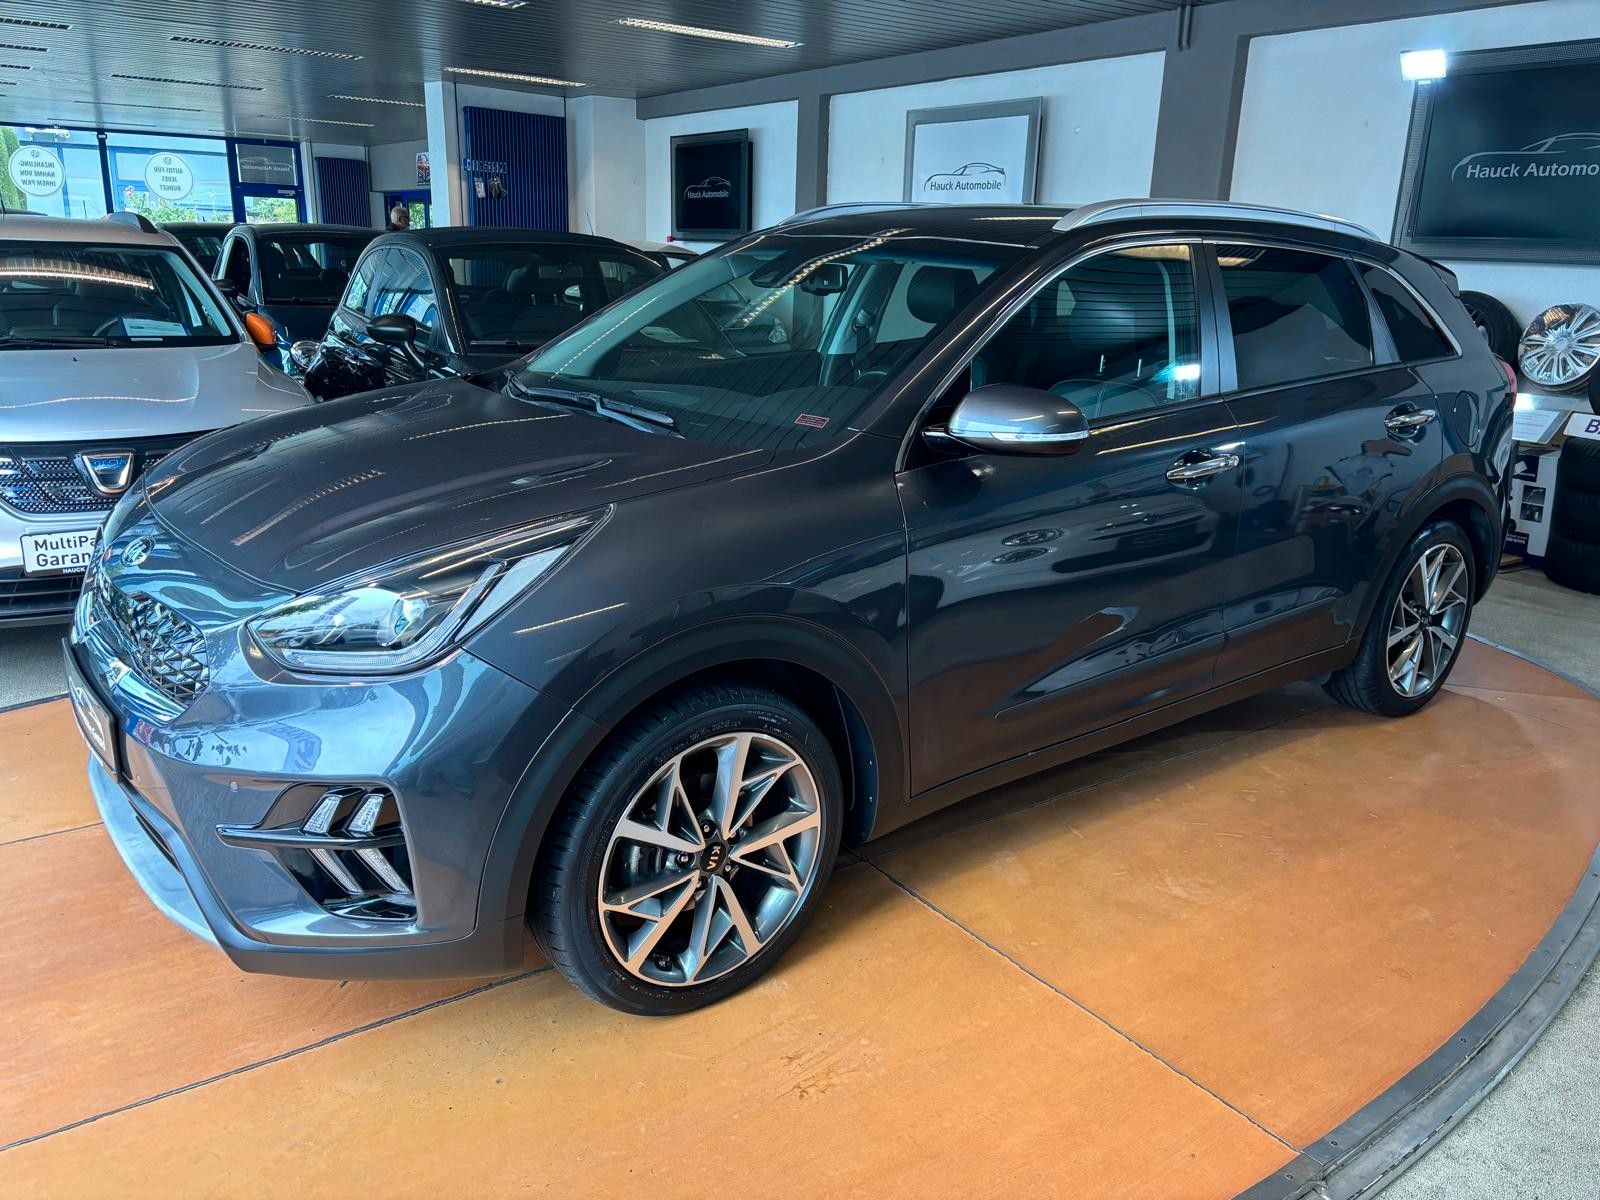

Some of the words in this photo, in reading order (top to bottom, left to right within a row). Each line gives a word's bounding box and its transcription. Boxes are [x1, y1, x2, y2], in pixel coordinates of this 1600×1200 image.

[1466, 163, 1520, 178] Hauck
[930, 181, 954, 191] Hauck
[955, 180, 1002, 190] Automobile
[687, 191, 701, 199] Hauck
[702, 190, 729, 198] Automobile
[62, 566, 86, 574] HAUCK
[706, 845, 721, 870] KIA
